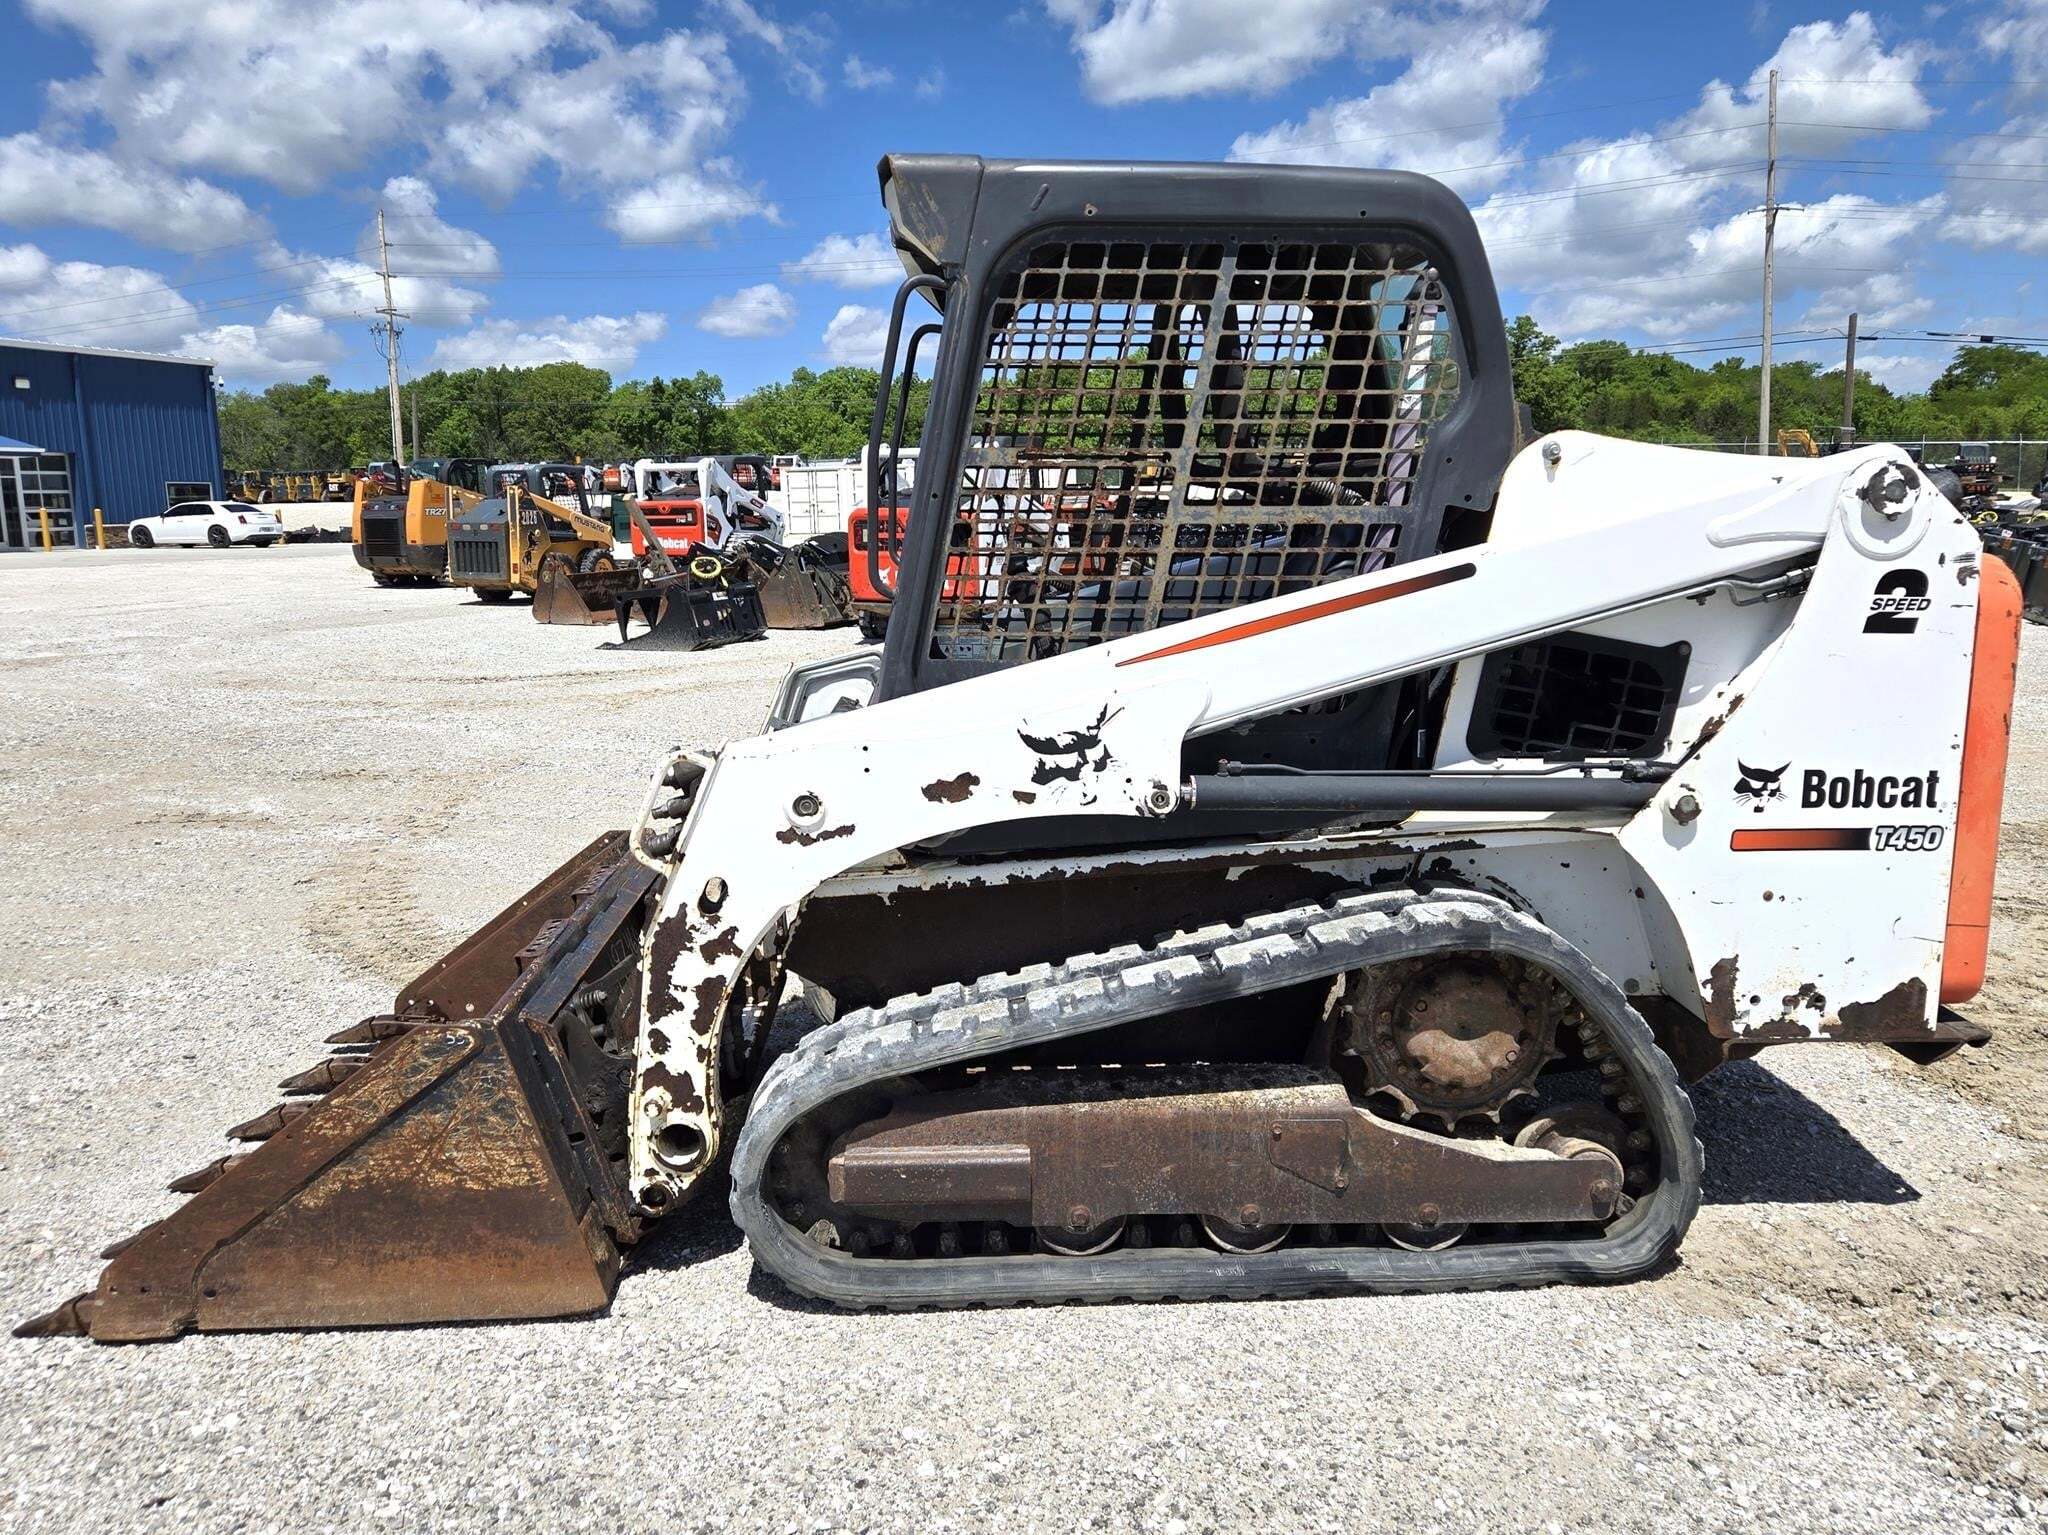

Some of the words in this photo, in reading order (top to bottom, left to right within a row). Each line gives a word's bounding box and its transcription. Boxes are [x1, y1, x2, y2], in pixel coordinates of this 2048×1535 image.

[1862, 568, 1929, 634] 2
[1869, 597, 1932, 612] SPEED
[1801, 768, 1940, 809] Bobcat
[1873, 825, 1945, 852] T450
